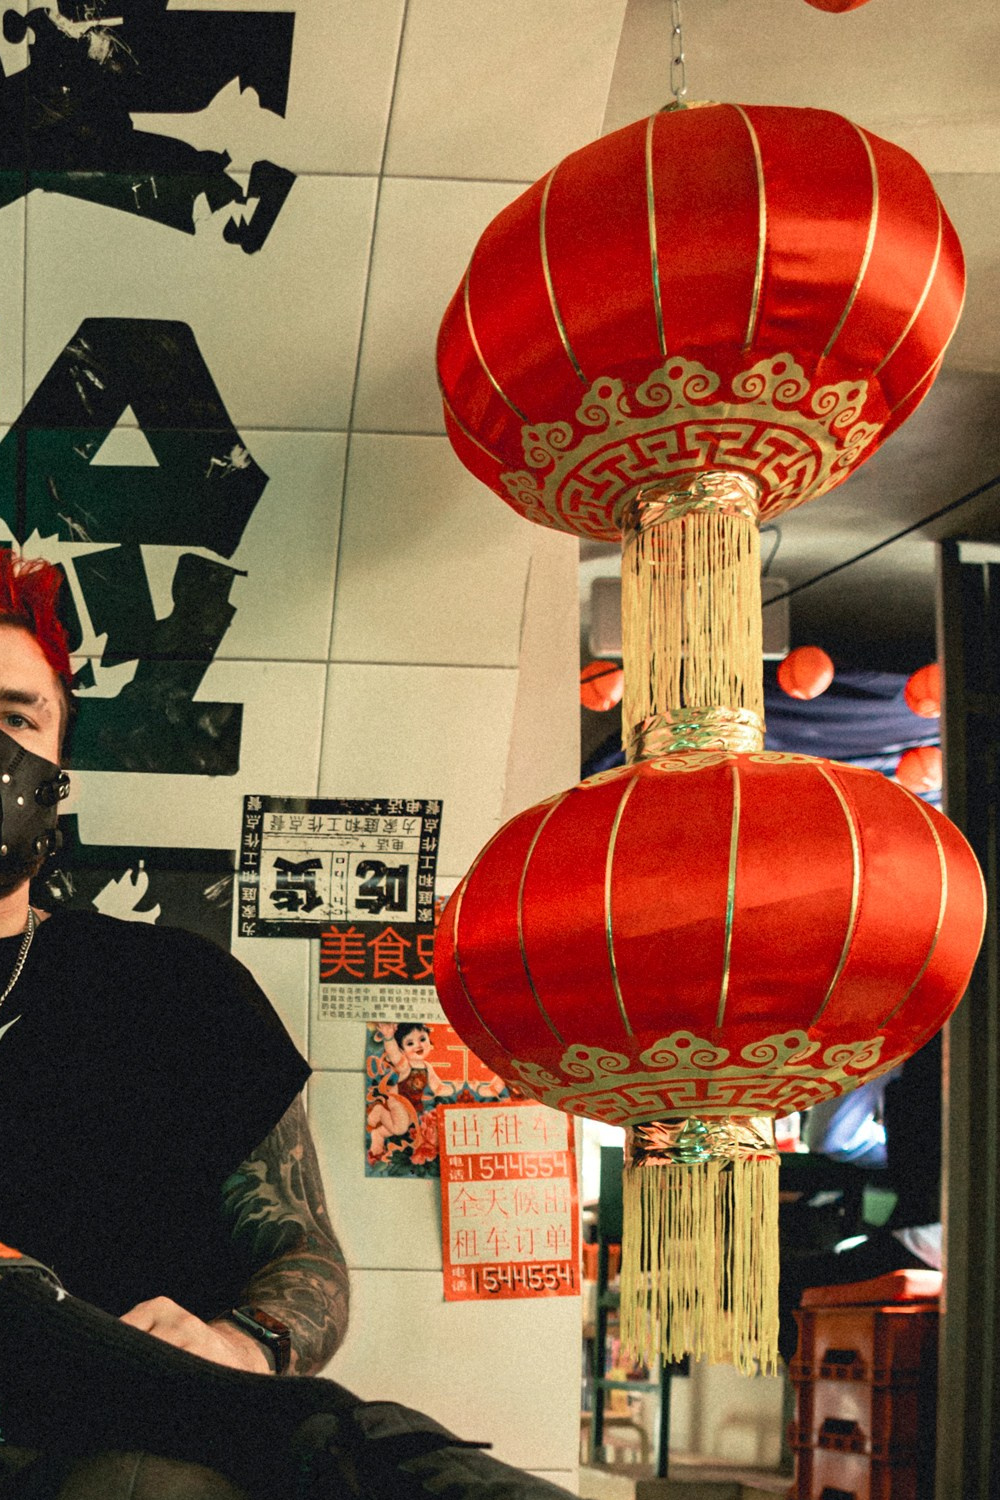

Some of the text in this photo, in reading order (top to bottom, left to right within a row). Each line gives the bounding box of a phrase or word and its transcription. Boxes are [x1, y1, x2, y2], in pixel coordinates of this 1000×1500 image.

[270, 815, 417, 834] 为家庭和工作点餐
[270, 856, 324, 913] 货
[355, 860, 409, 914] 吃
[468, 1153, 568, 1180] 1544554
[453, 1224, 570, 1259] 租车订单
[471, 1262, 571, 1292] 1544554
